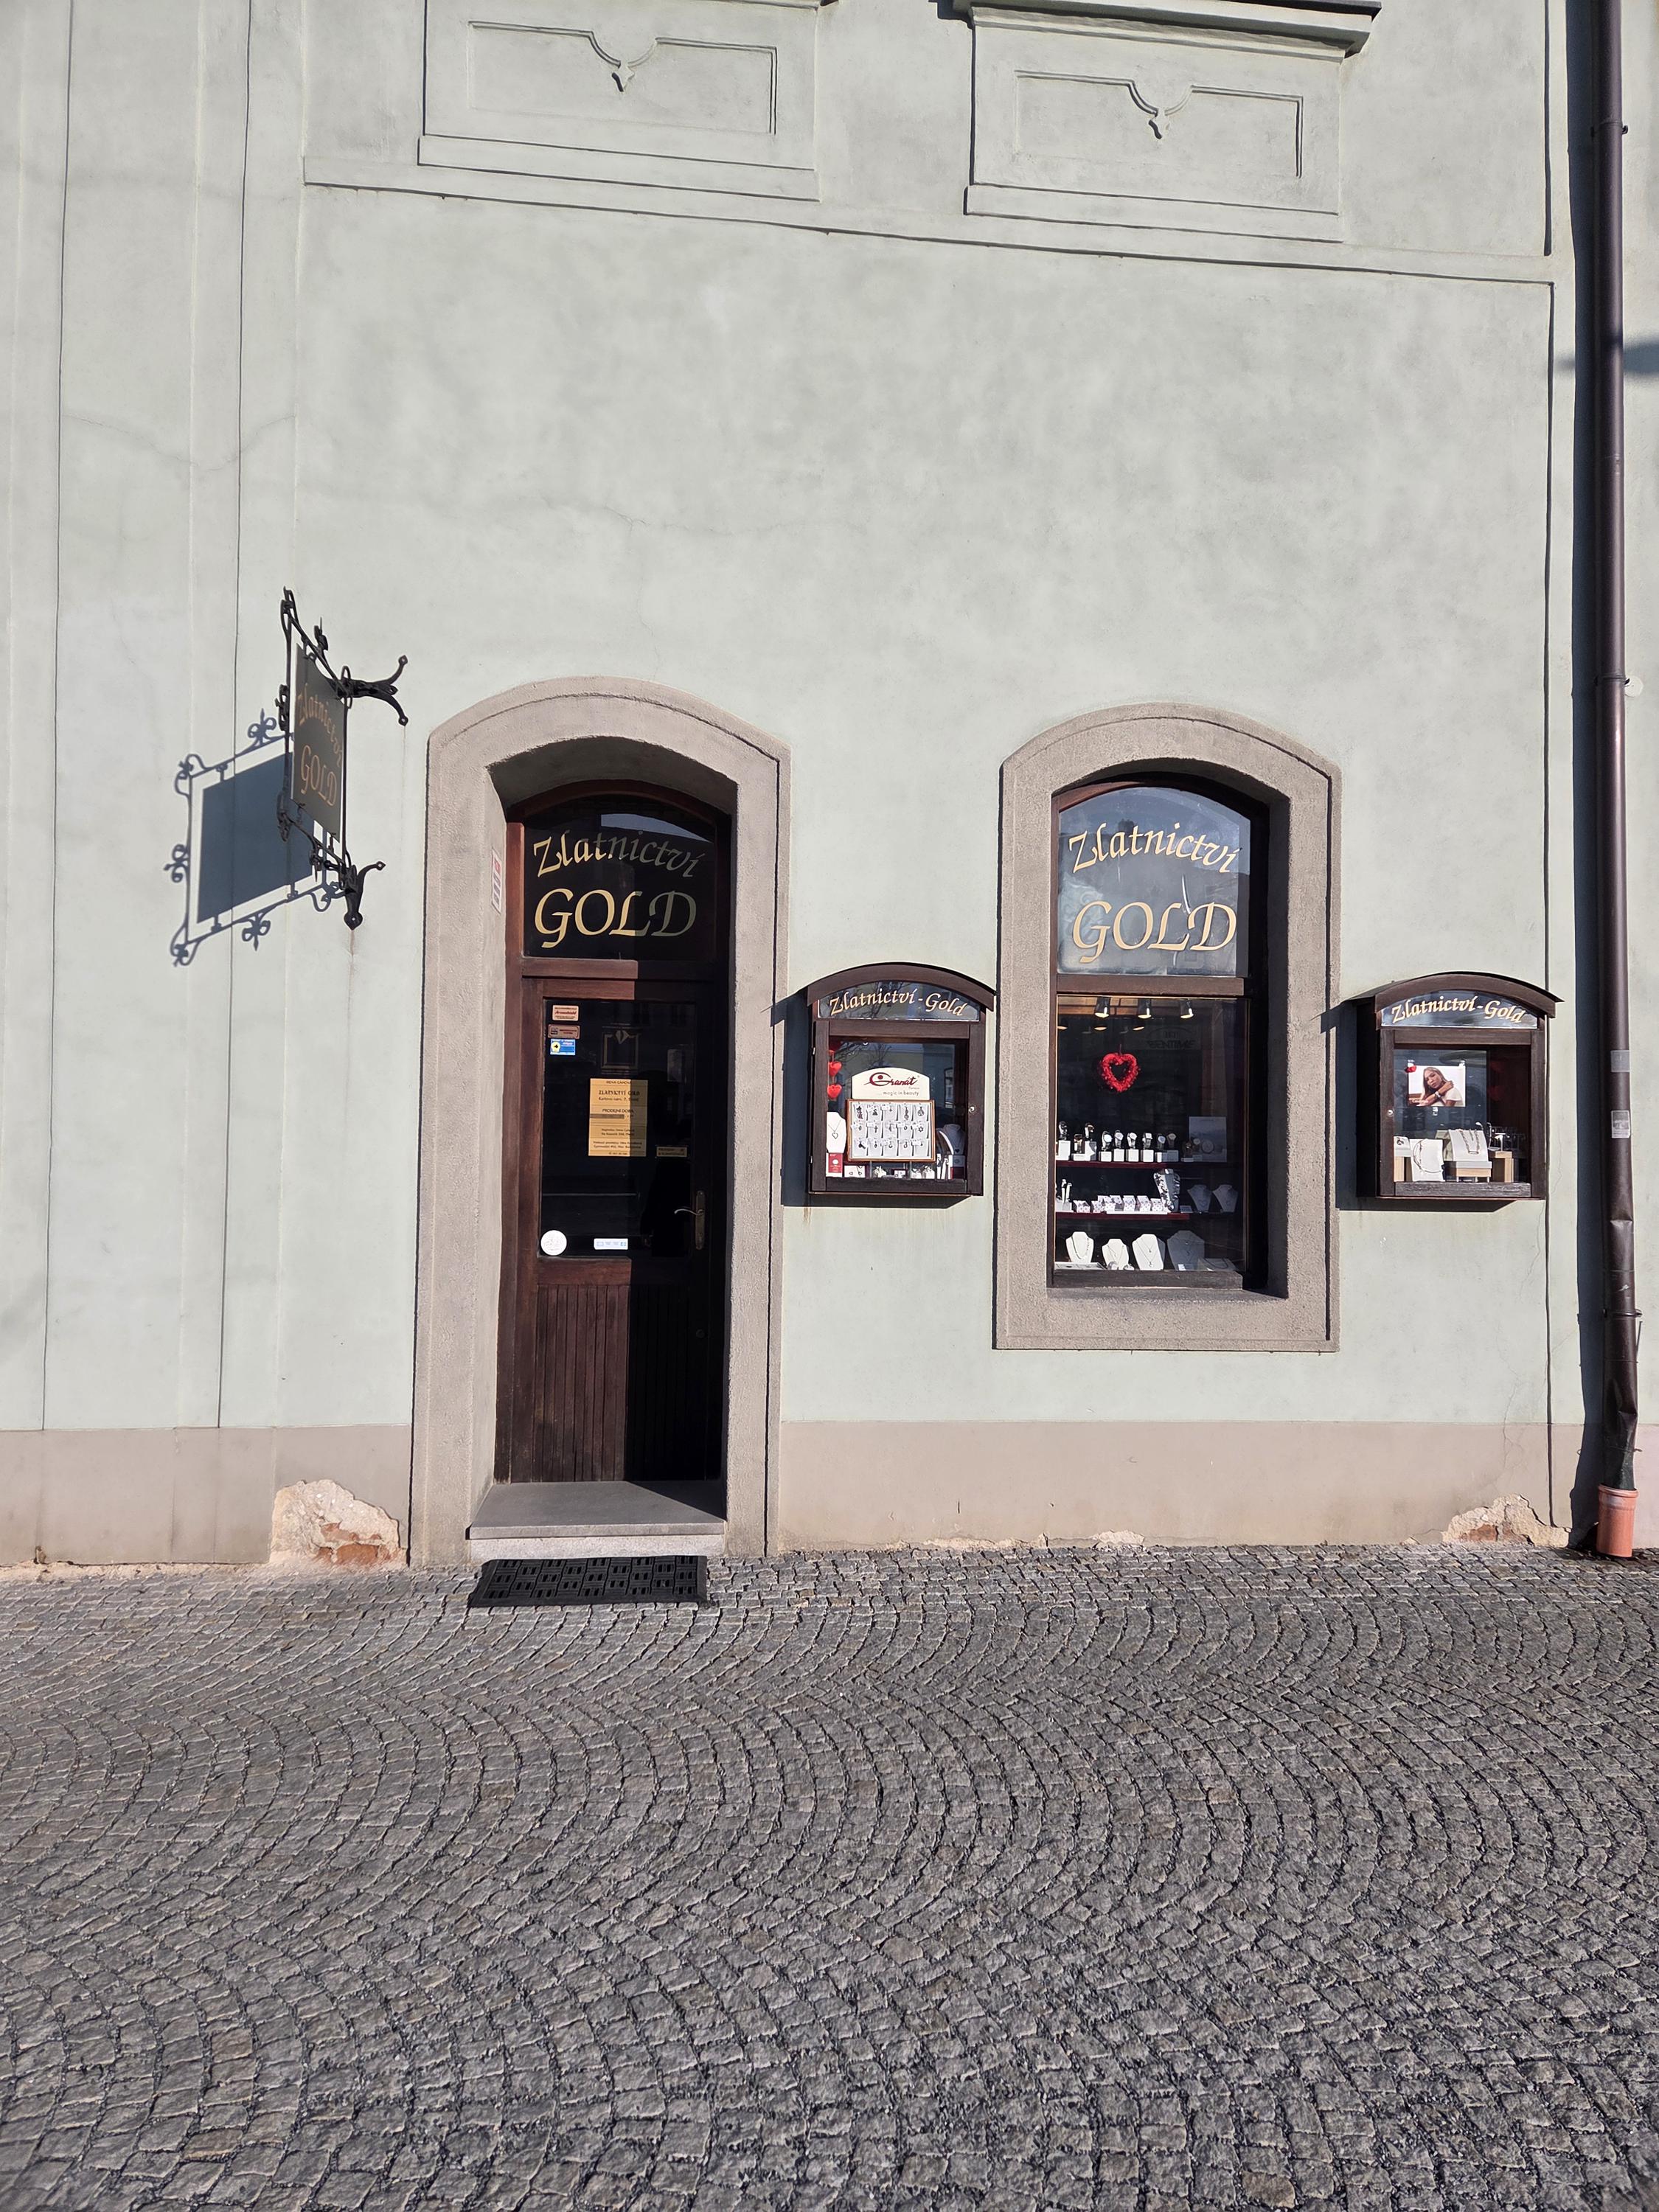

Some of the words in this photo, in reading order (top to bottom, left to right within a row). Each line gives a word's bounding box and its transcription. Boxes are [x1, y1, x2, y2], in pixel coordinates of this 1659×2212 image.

[301, 745, 337, 806] GOLD
[533, 830, 706, 877] Zlatnictví
[1068, 822, 1240, 874] Zlatnictví
[535, 888, 697, 948] GOLD
[1072, 900, 1237, 964] GOLD
